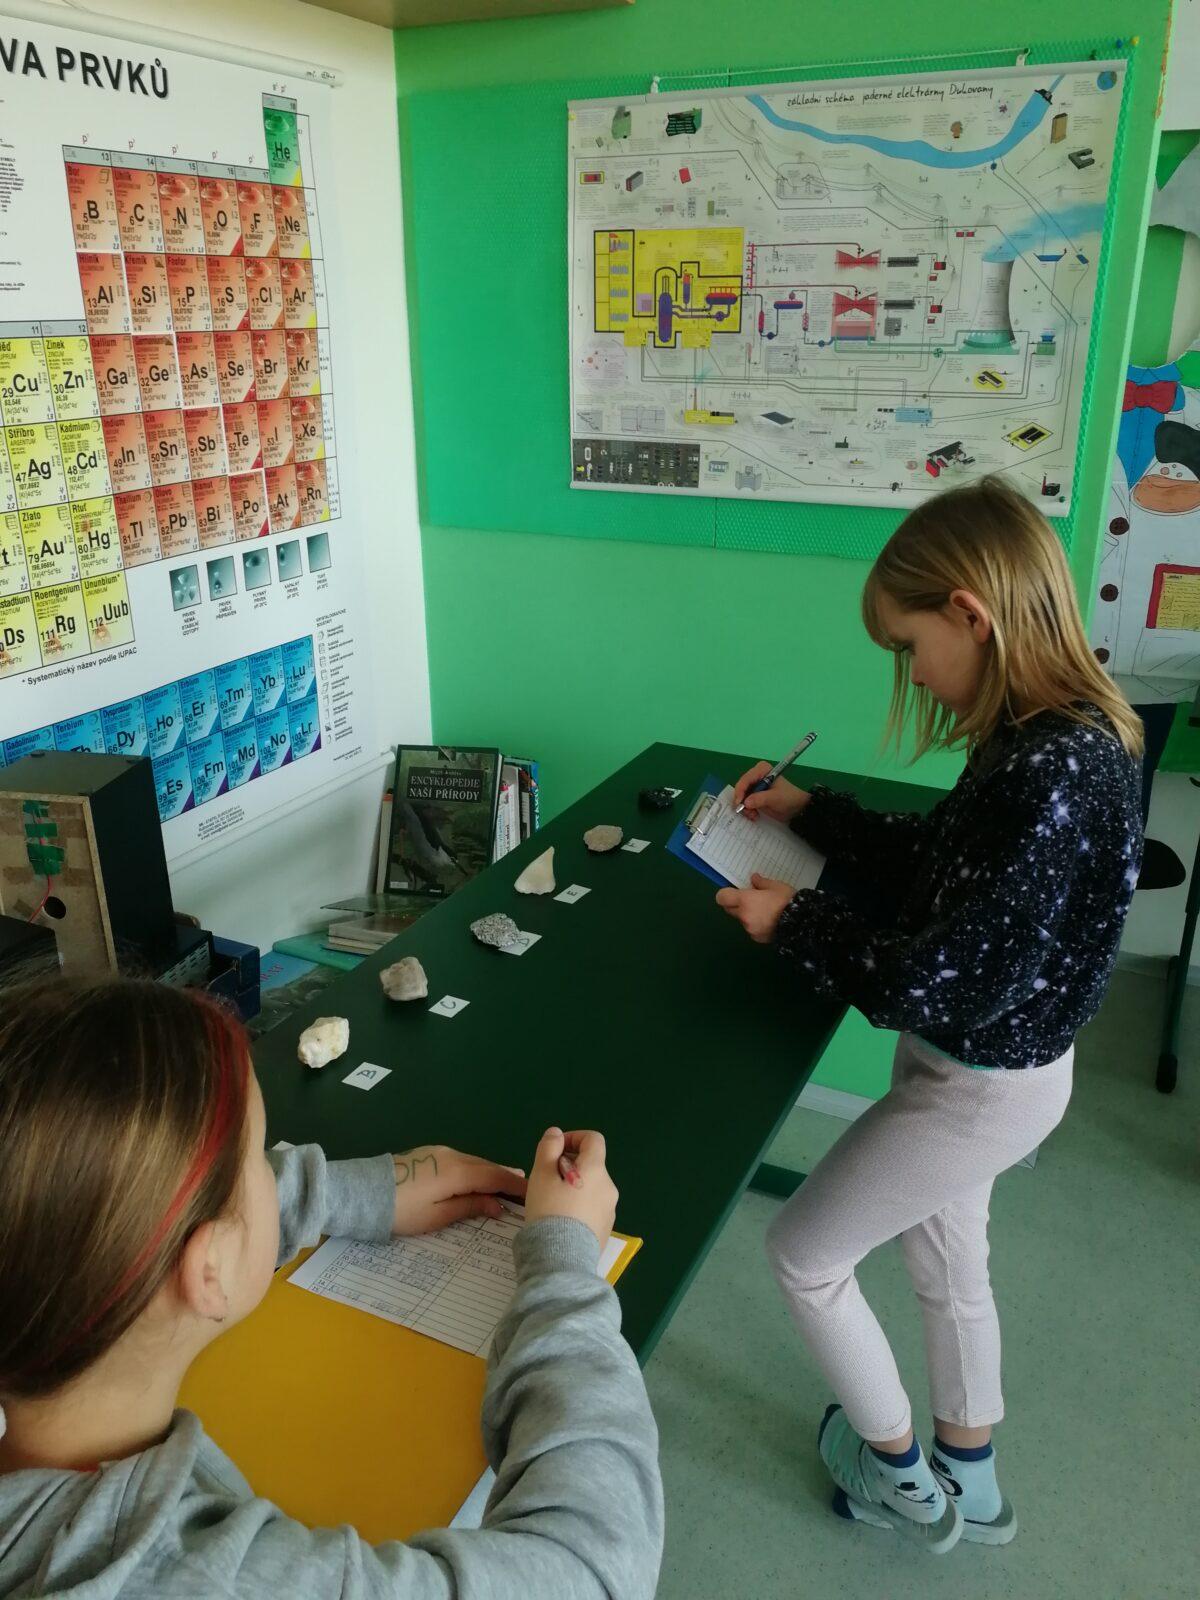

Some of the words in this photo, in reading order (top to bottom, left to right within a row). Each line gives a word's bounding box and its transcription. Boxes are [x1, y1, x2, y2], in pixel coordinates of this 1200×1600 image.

[56, 46, 168, 99] PRVKŮ
[897, 86, 945, 101] elektrárny
[950, 83, 994, 99] Dukovany
[101, 152, 109, 161] 13
[275, 141, 291, 160] He
[83, 213, 89, 223] 5
[87, 200, 99, 219] B
[130, 216, 135, 225] 6
[134, 204, 145, 222] C
[173, 219, 177, 228] 7
[177, 207, 187, 225] N
[213, 221, 218, 230] 8
[217, 210, 227, 227] O
[253, 213, 260, 229] F
[284, 215, 301, 232] Ne
[88, 298, 97, 308] 13
[97, 285, 114, 303] Al
[133, 298, 142, 307] 14
[141, 285, 156, 303] Si
[177, 298, 186, 307] 15
[186, 286, 195, 303] P
[217, 298, 225, 307] 16
[225, 287, 234, 303] S
[252, 298, 259, 307] 17
[260, 287, 272, 303] Cl
[293, 287, 306, 303] Ar
[31, 326, 39, 334] 11
[46, 340, 65, 349] Zinek
[181, 374, 189, 383] 33
[190, 363, 208, 379] As
[220, 372, 227, 381] 34
[227, 361, 244, 376] Se
[256, 370, 264, 379] 35
[263, 359, 278, 374] Br
[296, 356, 310, 372] Kr
[2, 388, 14, 398] 29
[13, 373, 39, 393] Cu
[54, 384, 64, 394] 30
[63, 370, 84, 389] Zn
[98, 380, 107, 391] 31
[107, 368, 128, 385] Ga
[141, 377, 150, 387] 32
[149, 365, 169, 382] Ge
[8, 428, 35, 439] Stříbro
[60, 423, 90, 433] Kadmium
[301, 423, 316, 438] Xe
[190, 448, 198, 457] 51
[197, 435, 216, 452] Sb
[229, 442, 236, 451] 52
[234, 431, 249, 446] Te
[113, 459, 122, 468] 49
[121, 446, 135, 463] In
[151, 454, 160, 463] 50
[159, 441, 178, 458] Sn
[15, 472, 26, 482] 47
[28, 459, 52, 480] Ag
[67, 466, 78, 475] 48
[76, 451, 98, 470] Cd
[276, 493, 289, 508] At
[306, 487, 322, 501] Rn
[22, 511, 41, 522] Zlato
[199, 519, 207, 528] 83
[206, 506, 220, 522] Bi
[235, 512, 243, 520] 84
[243, 500, 259, 514] Po
[123, 535, 131, 544] 81
[130, 521, 144, 538] Tl
[161, 526, 169, 535] 82
[169, 513, 187, 529] Pb
[29, 554, 40, 564] 79
[41, 539, 64, 558] Au
[78, 544, 88, 554] 80
[88, 530, 110, 549] Hg
[34, 585, 80, 600] Roentgenium
[89, 617, 103, 628] 112
[103, 600, 129, 621] Uub
[4, 628, 25, 647] Ds
[40, 629, 56, 641] 111
[55, 615, 76, 634] Rg
[27, 664, 75, 686] Systematický
[77, 660, 97, 671] název
[98, 652, 117, 666] podle
[118, 647, 138, 659] IUPAC
[292, 665, 306, 679] Lu
[254, 685, 261, 694] 70
[260, 675, 276, 690] Yb
[221, 700, 228, 709] 69
[225, 688, 244, 703] Tm
[185, 714, 193, 723] 68
[192, 701, 205, 717] Er
[56, 719, 84, 733] Terbium
[157, 715, 174, 732] Ho
[301, 721, 313, 736] Lr
[117, 730, 136, 747] Dy
[270, 734, 286, 748] No
[237, 743, 256, 762] Md
[204, 761, 224, 778] Fm
[166, 779, 183, 796] Es
[411, 776, 480, 788] ENCYKLOPEDIE
[409, 787, 432, 798] NAŠÍ
[435, 788, 480, 801] PŘÍRODY
[440, 1000, 456, 1010] C
